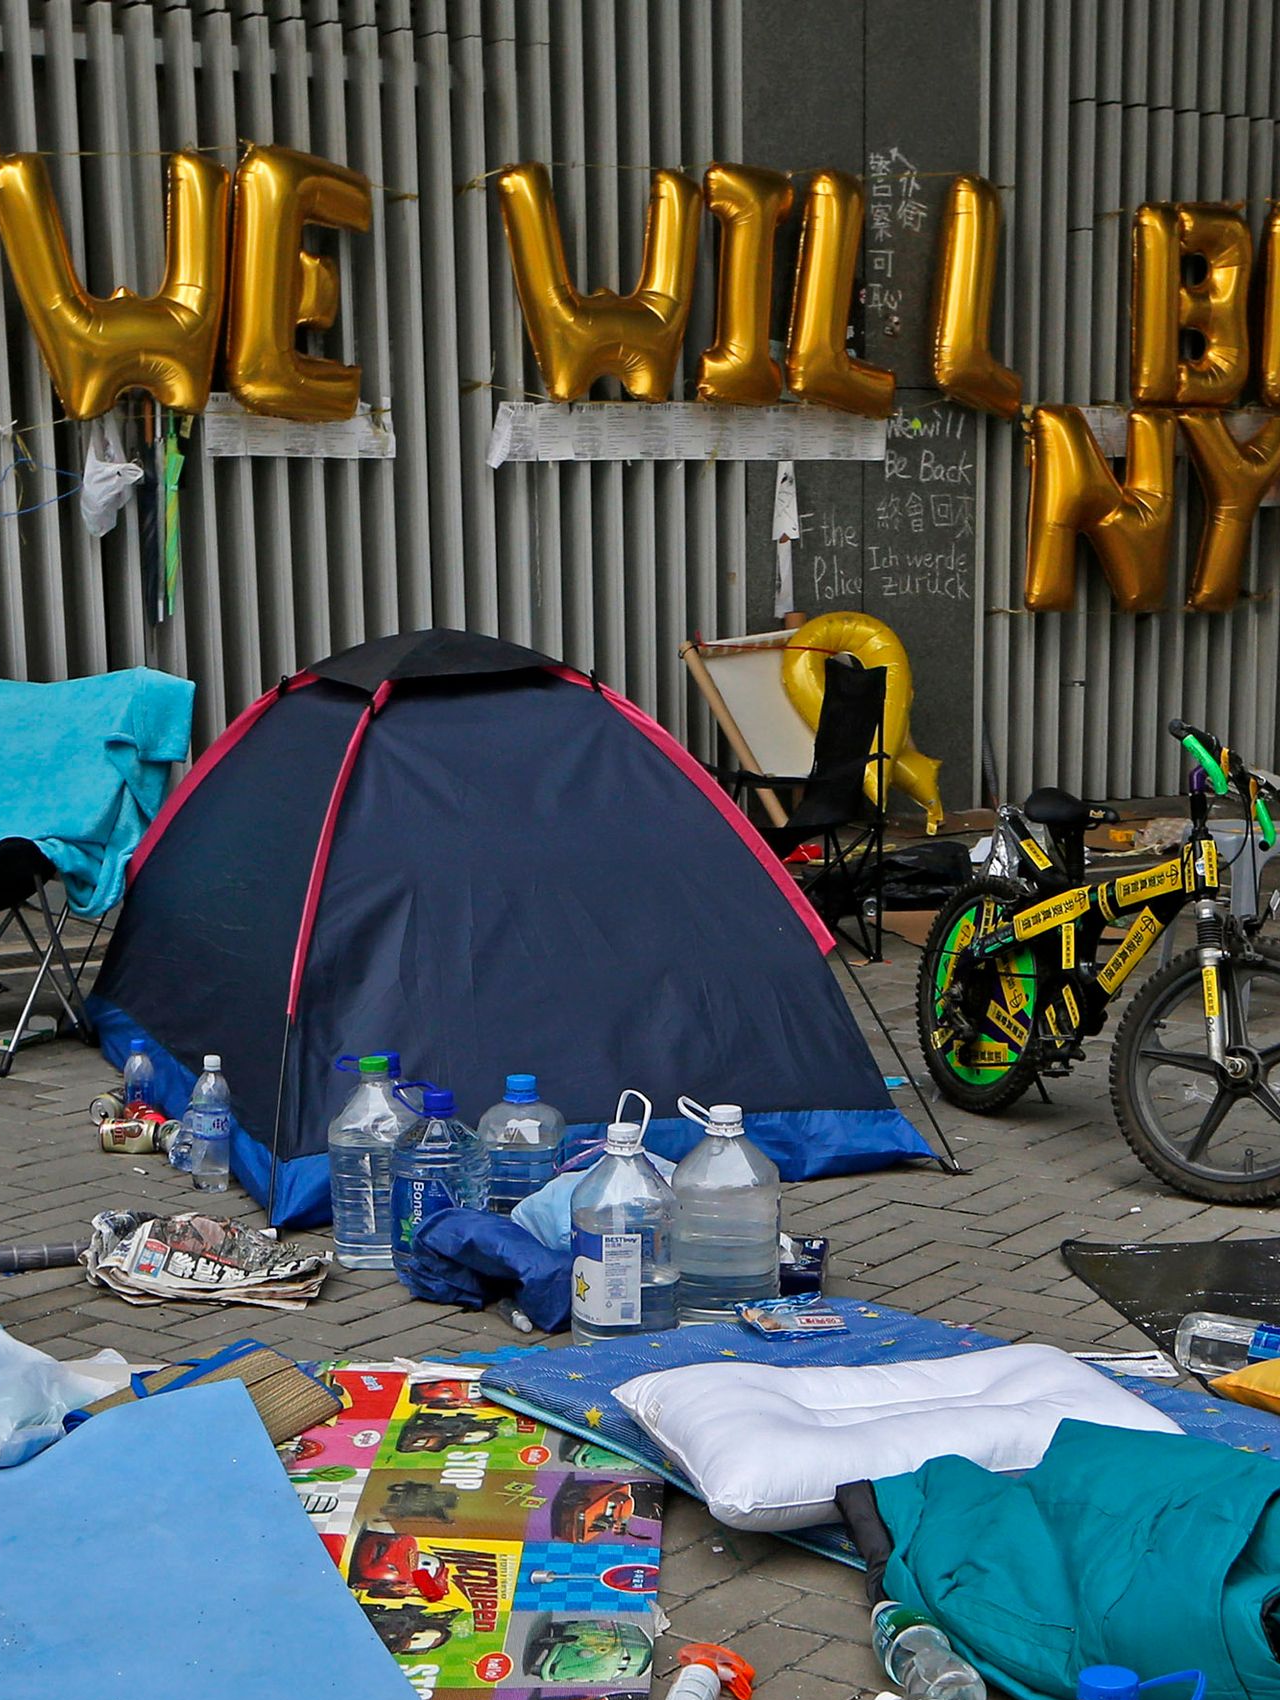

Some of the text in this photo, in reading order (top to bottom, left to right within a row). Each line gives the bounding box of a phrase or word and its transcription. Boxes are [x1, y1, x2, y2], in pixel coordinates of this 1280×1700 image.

[497, 161, 1022, 420] WILL
[885, 450, 974, 484] Be Back
[822, 506, 859, 547] the
[813, 555, 864, 600] Police
[868, 543, 968, 573] Ich werde
[439, 1451, 490, 1491] STOP
